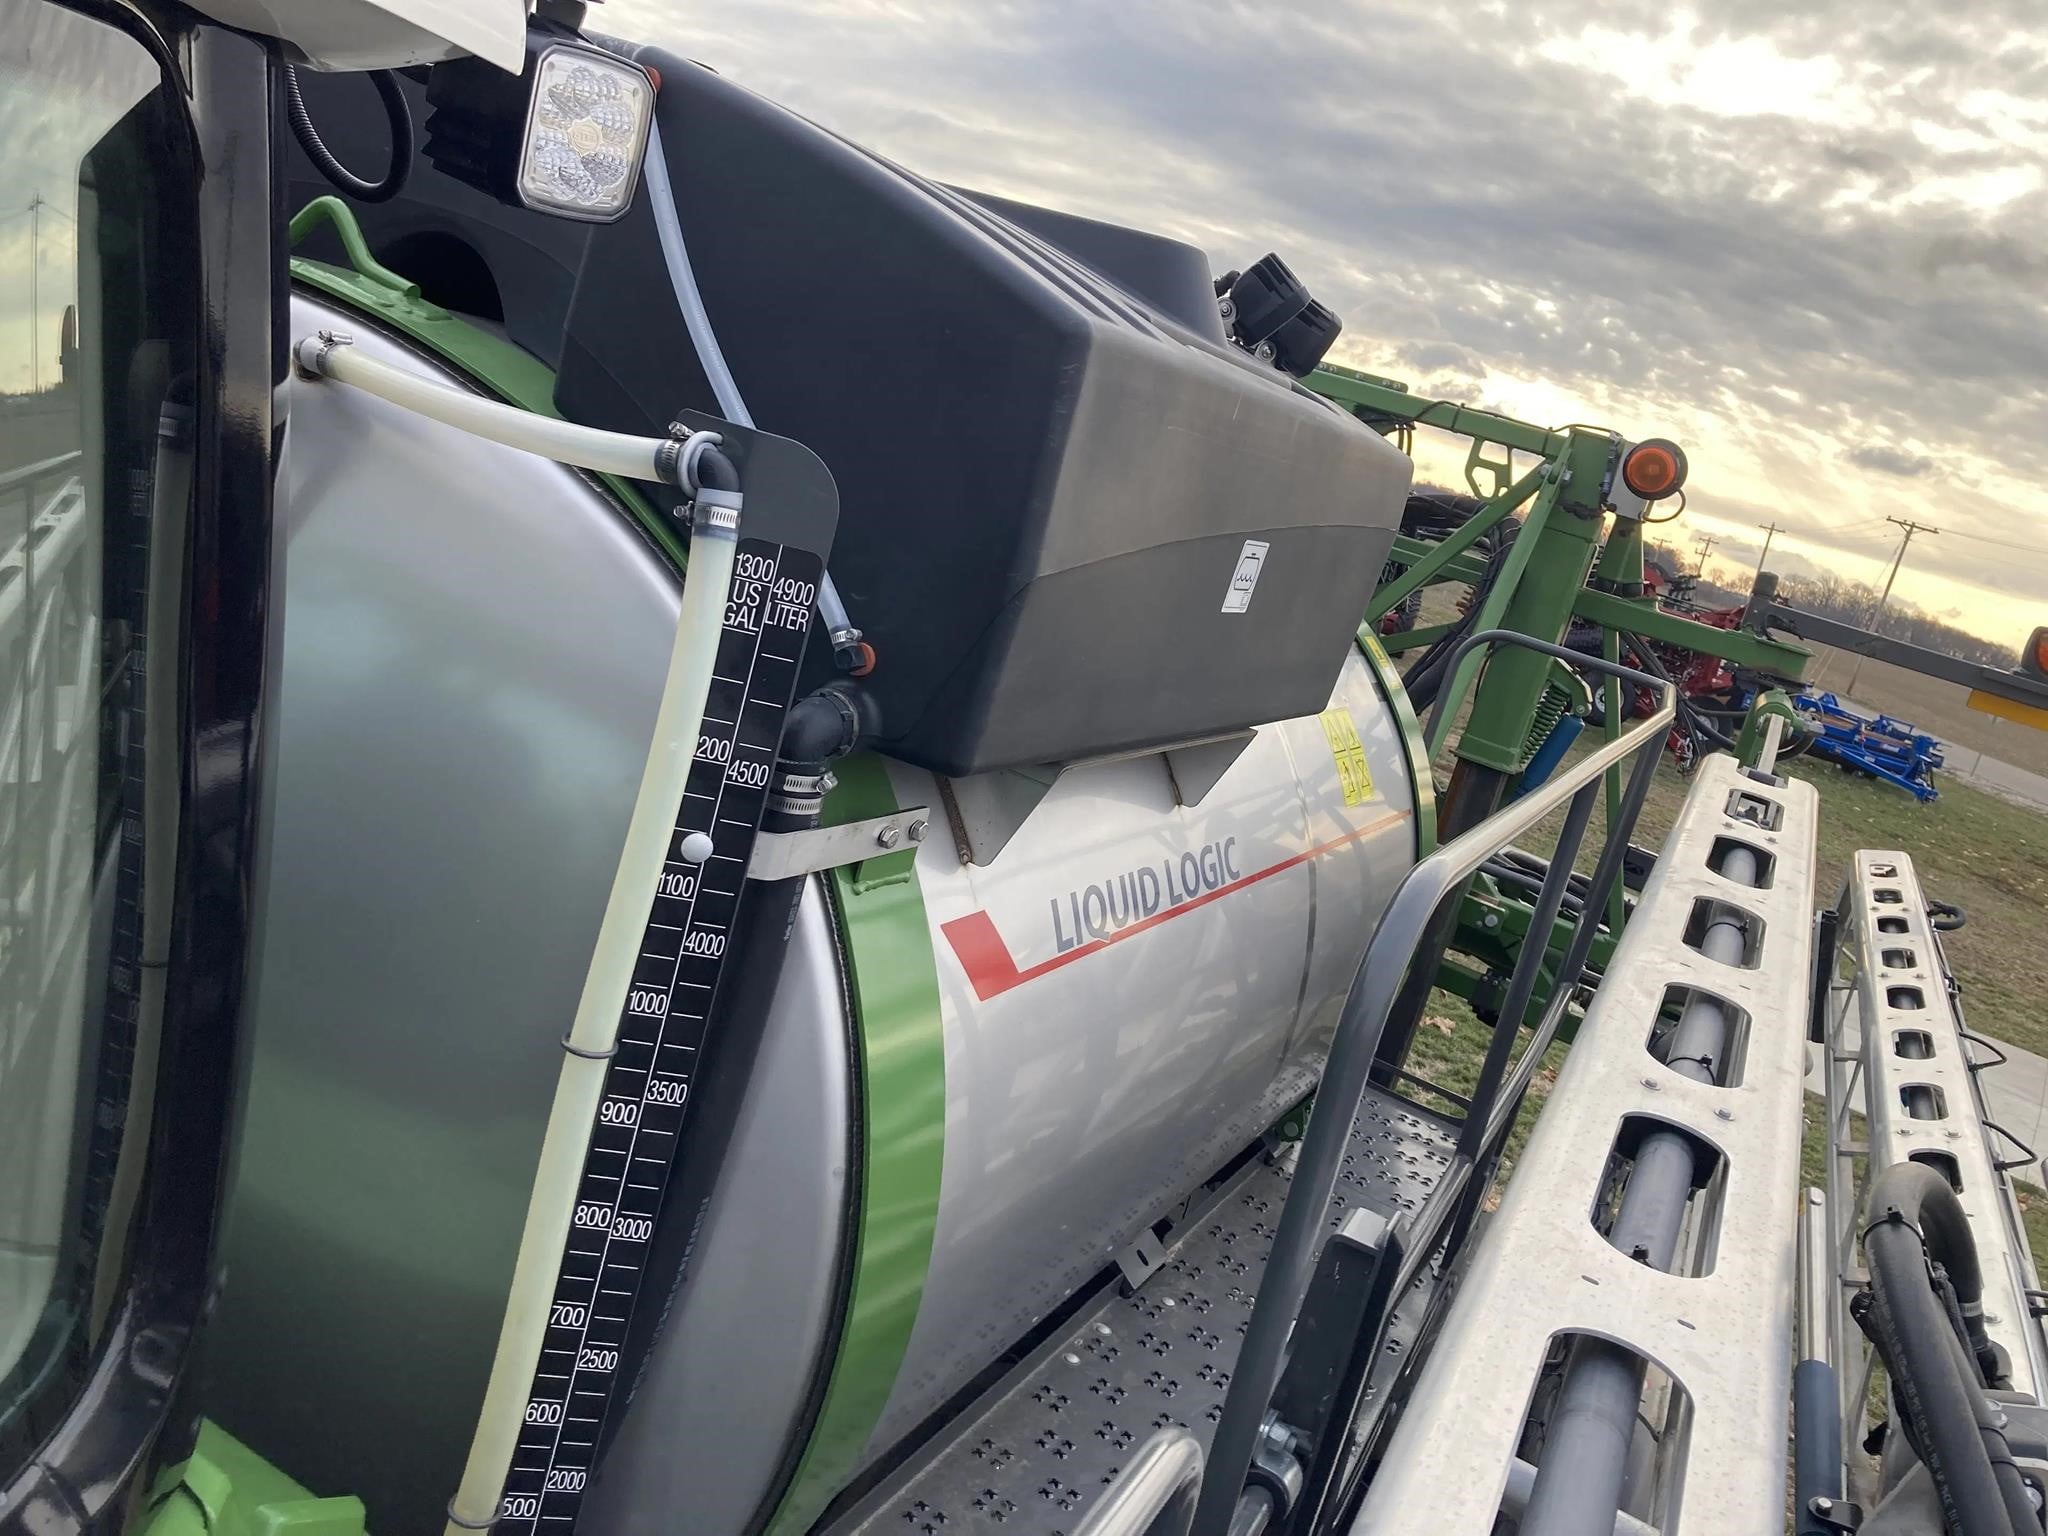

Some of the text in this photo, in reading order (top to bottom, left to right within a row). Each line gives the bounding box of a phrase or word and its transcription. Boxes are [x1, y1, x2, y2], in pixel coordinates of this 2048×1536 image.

[736, 552, 774, 582] 1300
[732, 580, 762, 606] US
[773, 577, 815, 606] 4900
[723, 602, 760, 631] GAL
[764, 601, 809, 632] LITER
[694, 735, 730, 761] 200
[728, 759, 769, 786] 4500
[658, 872, 695, 898] 1100
[1050, 836, 1240, 953] LIQUID LOGIC
[685, 931, 726, 956] 4000
[629, 990, 667, 1015] 1000
[647, 1079, 688, 1104] 3500
[600, 1101, 638, 1124] 900
[575, 1205, 611, 1227] 800
[612, 1217, 652, 1240] 3000
[550, 1305, 585, 1327] 700
[578, 1349, 618, 1370] 2500
[525, 1403, 561, 1424] 600
[547, 1470, 587, 1490] 2000
[503, 1497, 537, 1517] 500
